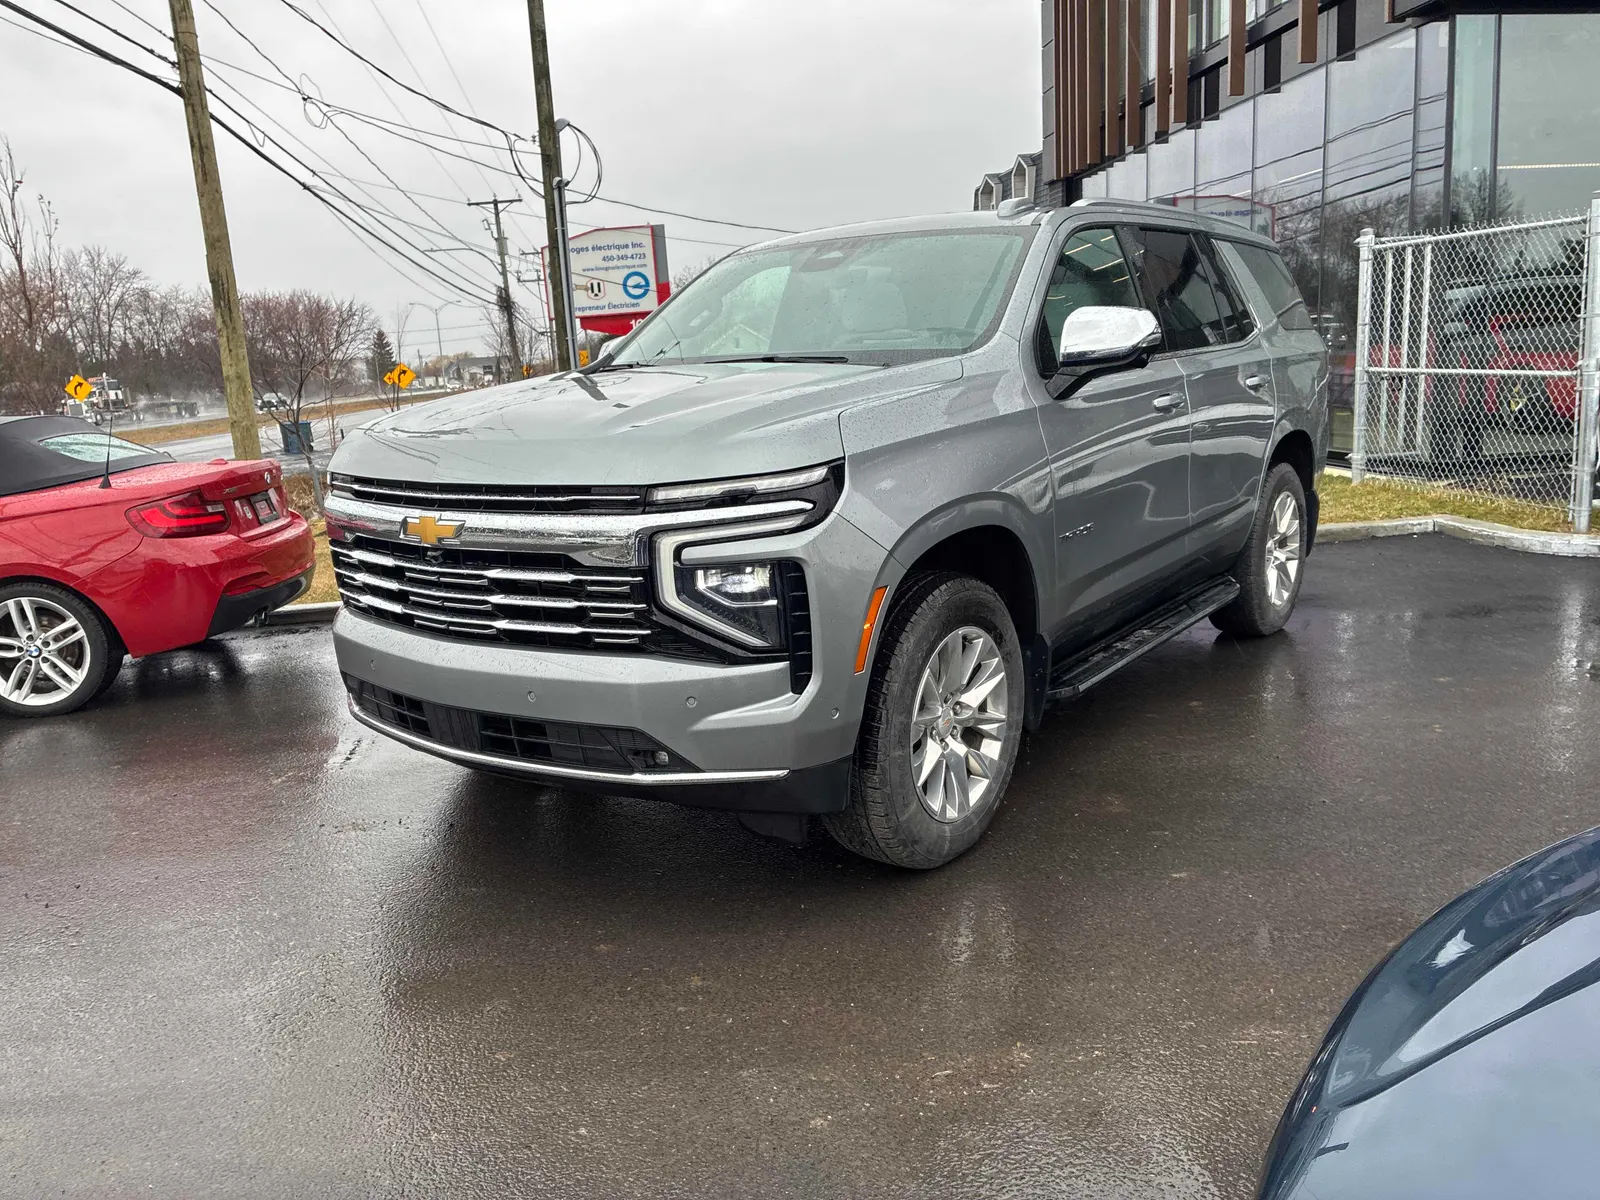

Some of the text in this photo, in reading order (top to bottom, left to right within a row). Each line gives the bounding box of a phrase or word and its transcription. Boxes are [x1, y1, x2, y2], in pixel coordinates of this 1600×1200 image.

[568, 241, 646, 254] oges électrique Inc.
[602, 253, 647, 262] 450-349-4723
[574, 301, 640, 312] repreneur Électricien
